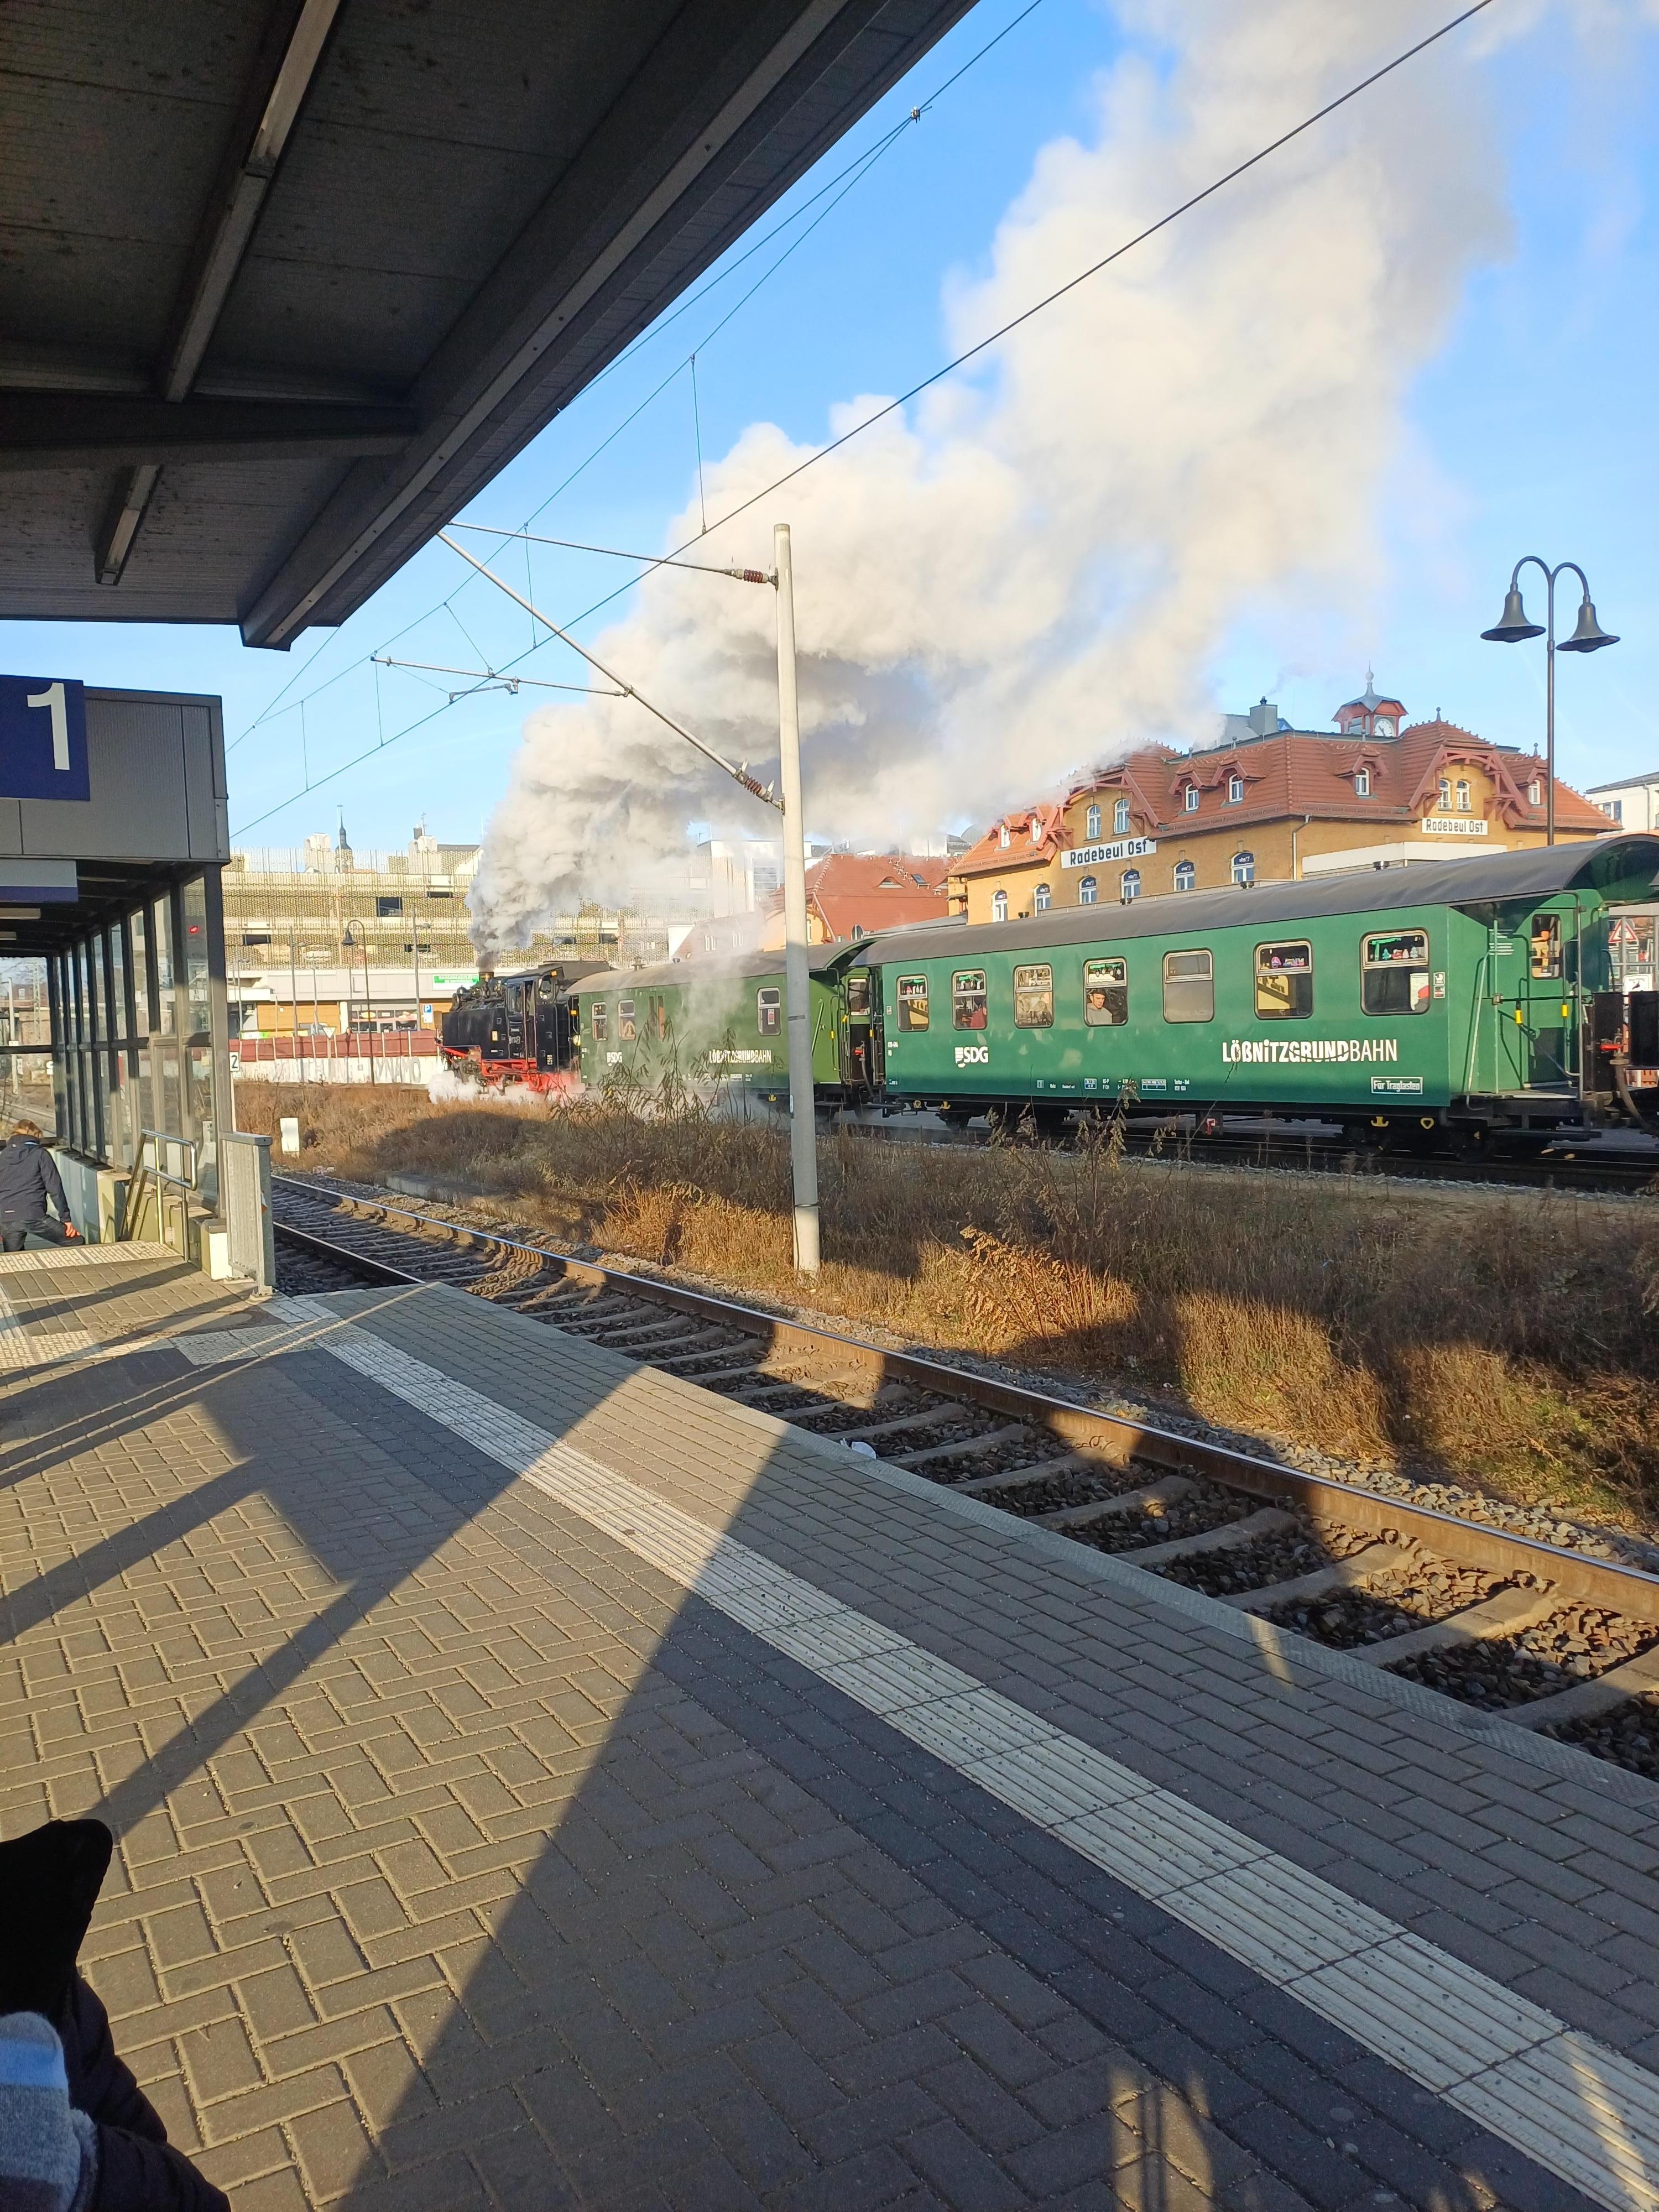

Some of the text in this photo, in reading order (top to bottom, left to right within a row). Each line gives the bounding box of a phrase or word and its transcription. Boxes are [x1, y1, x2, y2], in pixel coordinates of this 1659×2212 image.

[27, 682, 70, 770] 1
[1426, 818, 1484, 833] Radebeul Ost
[1070, 839, 1147, 865] Radebeul Ost
[231, 1055, 238, 1068] 2
[611, 1051, 623, 1063] SDG
[963, 1046, 989, 1063] SDG
[1374, 1080, 1420, 1092] Für Traglasten
